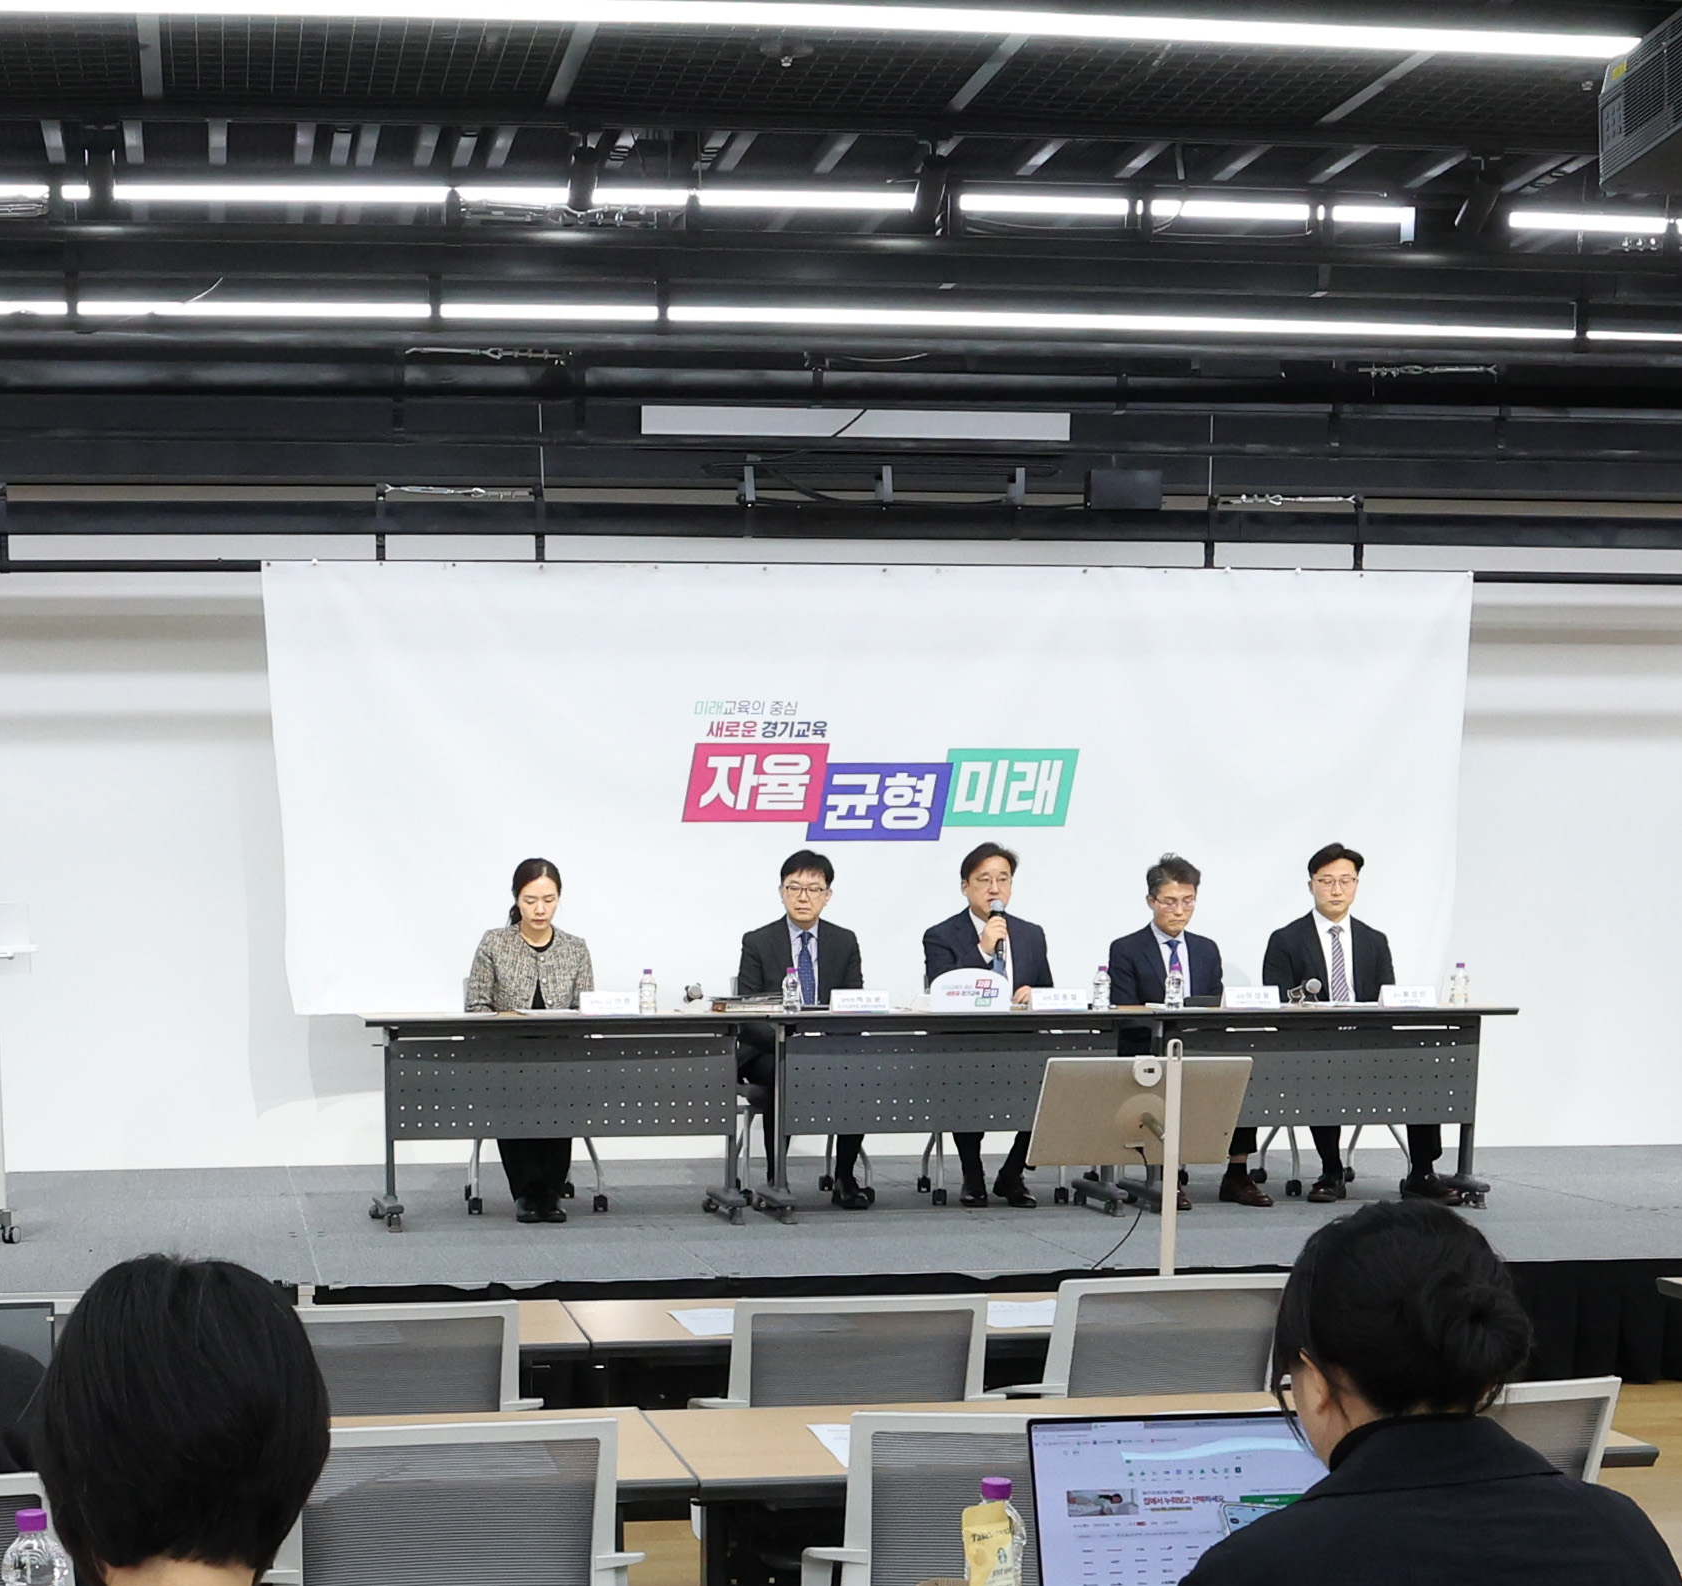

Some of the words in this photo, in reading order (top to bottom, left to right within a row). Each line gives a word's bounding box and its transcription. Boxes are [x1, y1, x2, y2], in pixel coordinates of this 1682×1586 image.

[693, 699, 765, 717] 미래교육의
[769, 699, 798, 716] 중심
[706, 720, 758, 739] 새로운
[761, 720, 828, 739] 경기교육
[698, 753, 814, 811] 자율
[823, 772, 937, 831] 균형
[953, 758, 1064, 816] 미래
